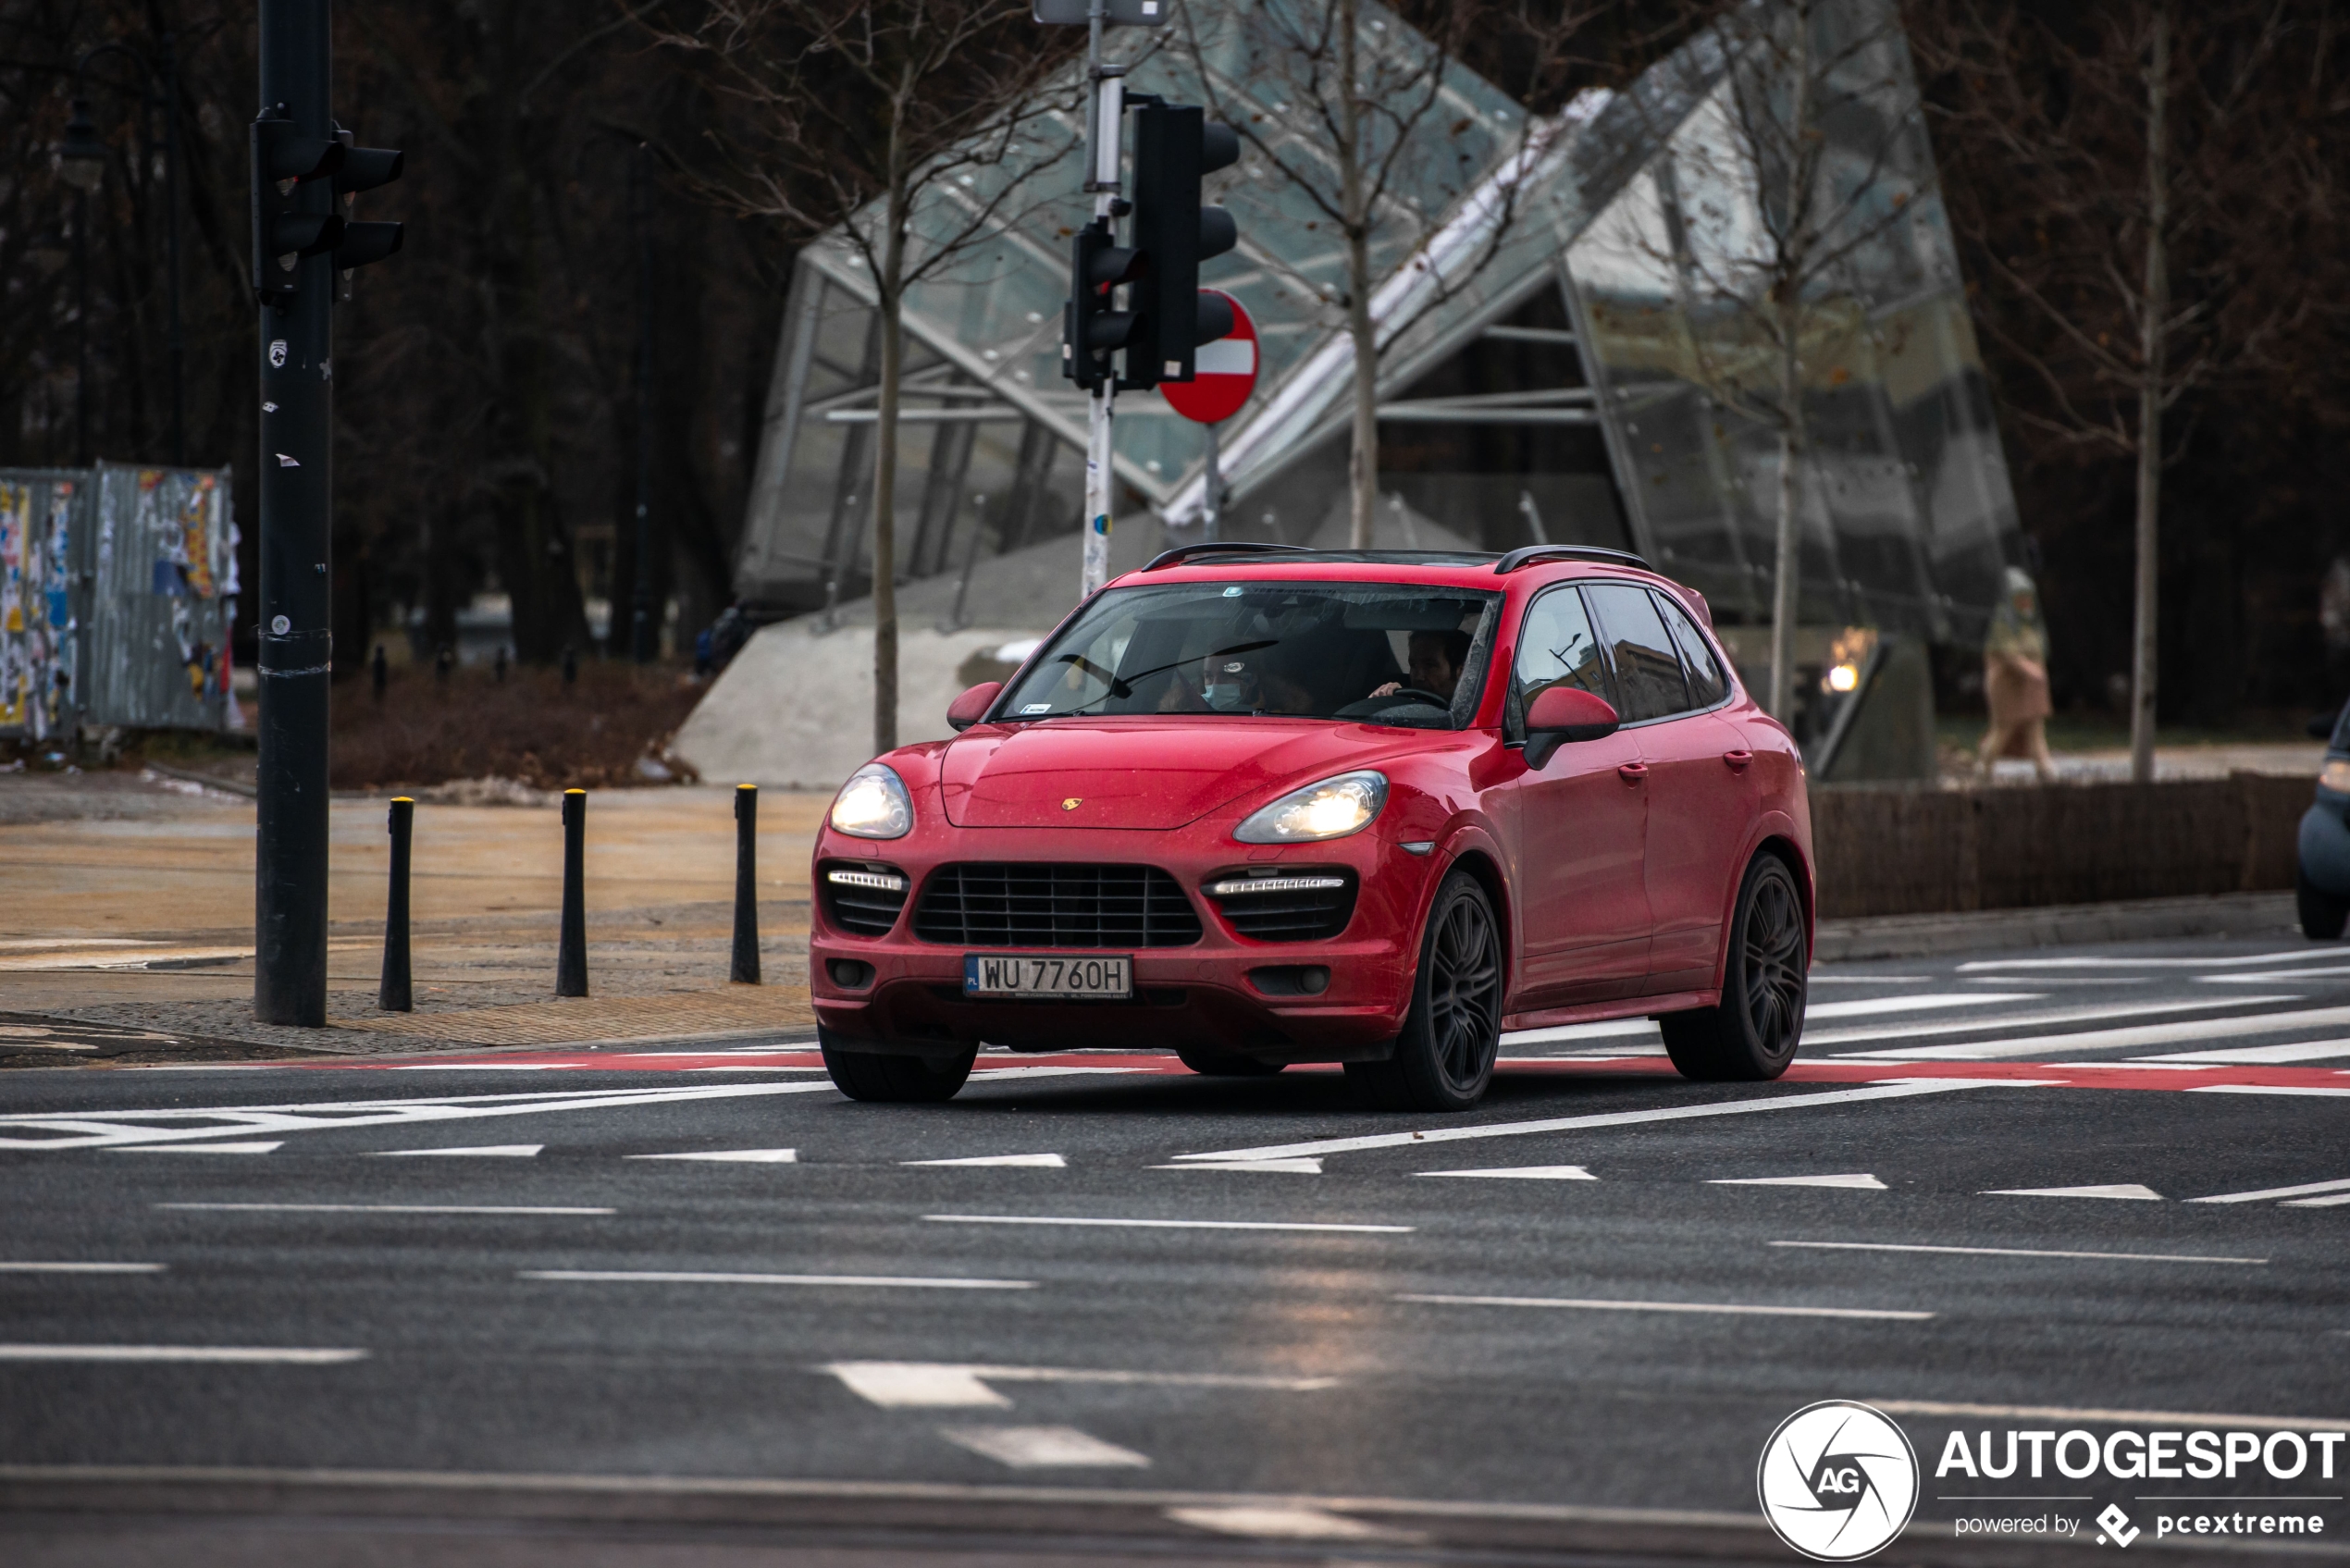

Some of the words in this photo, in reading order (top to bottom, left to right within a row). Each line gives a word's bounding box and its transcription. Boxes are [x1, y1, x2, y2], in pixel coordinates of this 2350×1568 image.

[968, 977, 978, 986] PL
[984, 959, 1020, 989] WU
[1032, 960, 1121, 990] 7760H
